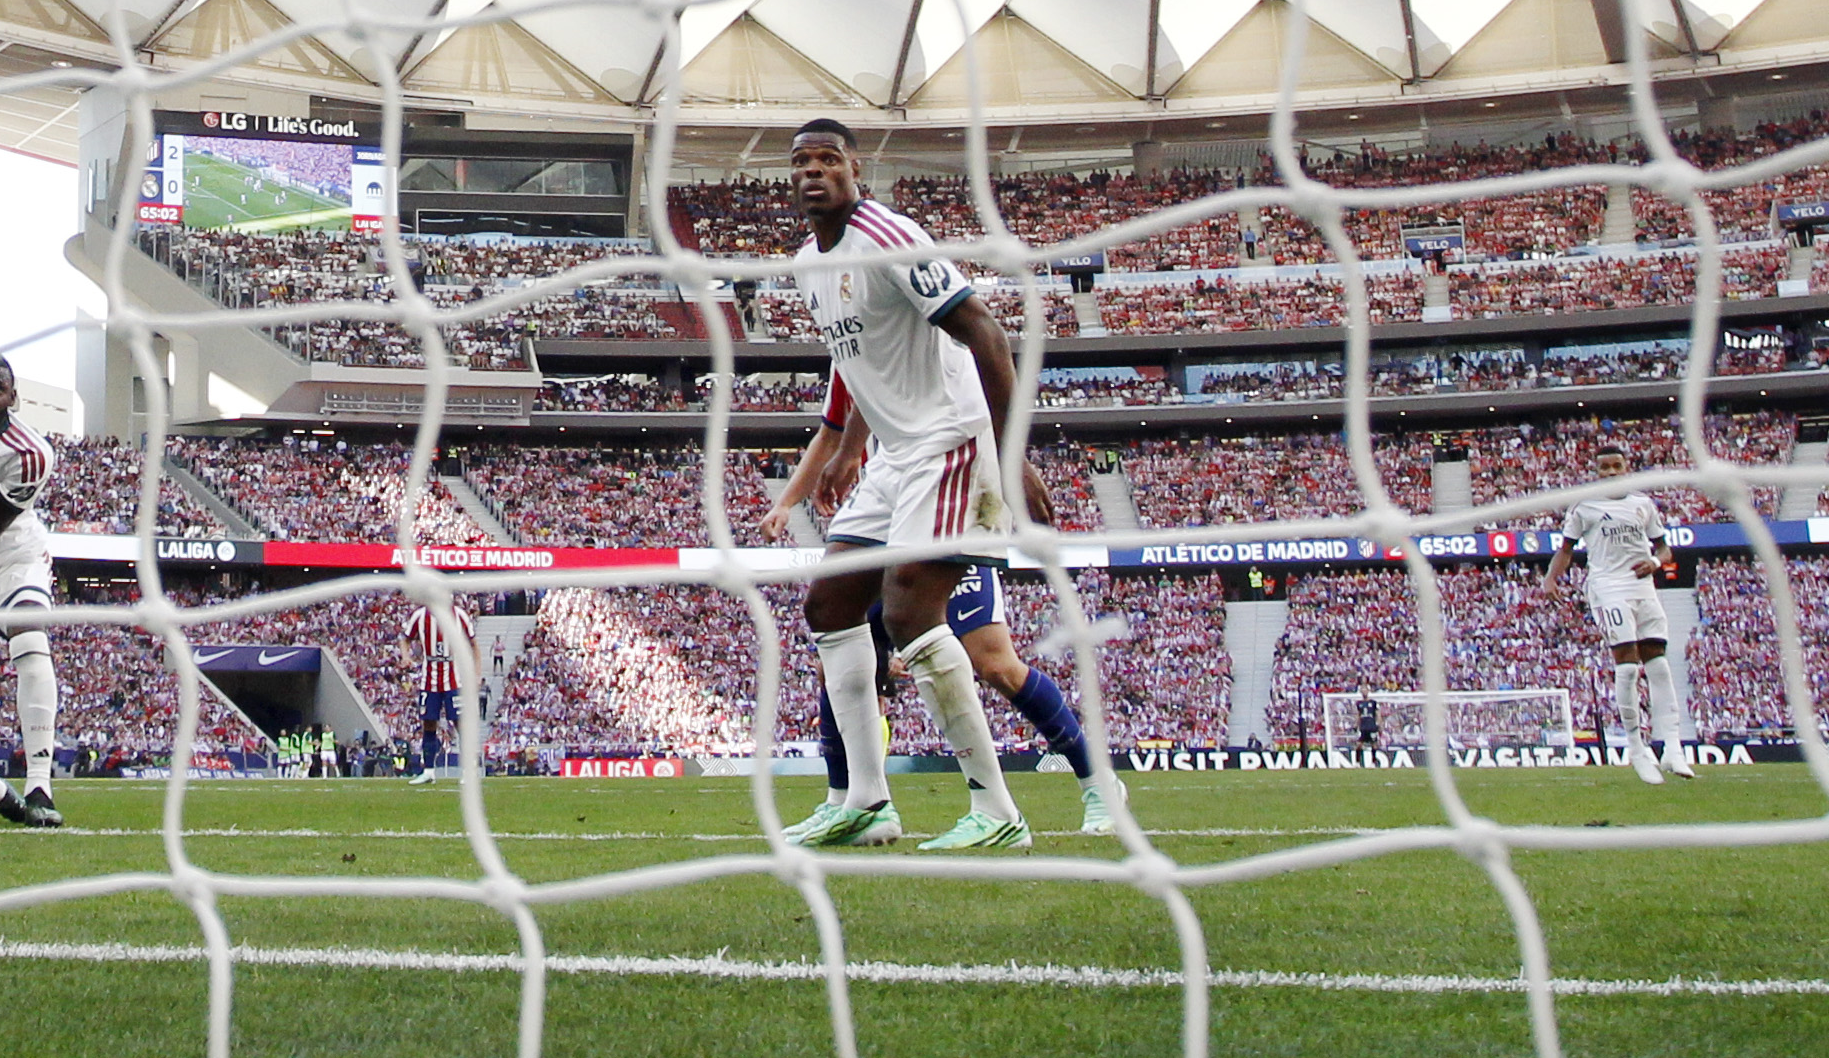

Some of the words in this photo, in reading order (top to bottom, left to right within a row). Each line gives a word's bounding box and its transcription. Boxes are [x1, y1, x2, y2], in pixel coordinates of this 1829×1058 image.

[221, 113, 247, 131] LG
[267, 116, 307, 135] Life's
[310, 118, 360, 138] Good.
[168, 145, 178, 160] 2
[168, 180, 178, 194] 0
[140, 206, 178, 221] 65:02
[1791, 205, 1826, 217] VELO
[1417, 239, 1450, 250] VELO
[1061, 256, 1092, 266] VELO
[157, 541, 215, 560] LALIGA
[1141, 542, 1235, 564] ATLÉTICO
[1237, 542, 1264, 562] DE
[1268, 540, 1349, 560] MADRID
[1419, 536, 1478, 556] 65:02
[1493, 534, 1509, 553] 0
[485, 550, 554, 568] MADRID
[1604, 607, 1624, 627] 10
[420, 691, 428, 706] 7
[565, 760, 647, 778] LALIGA
